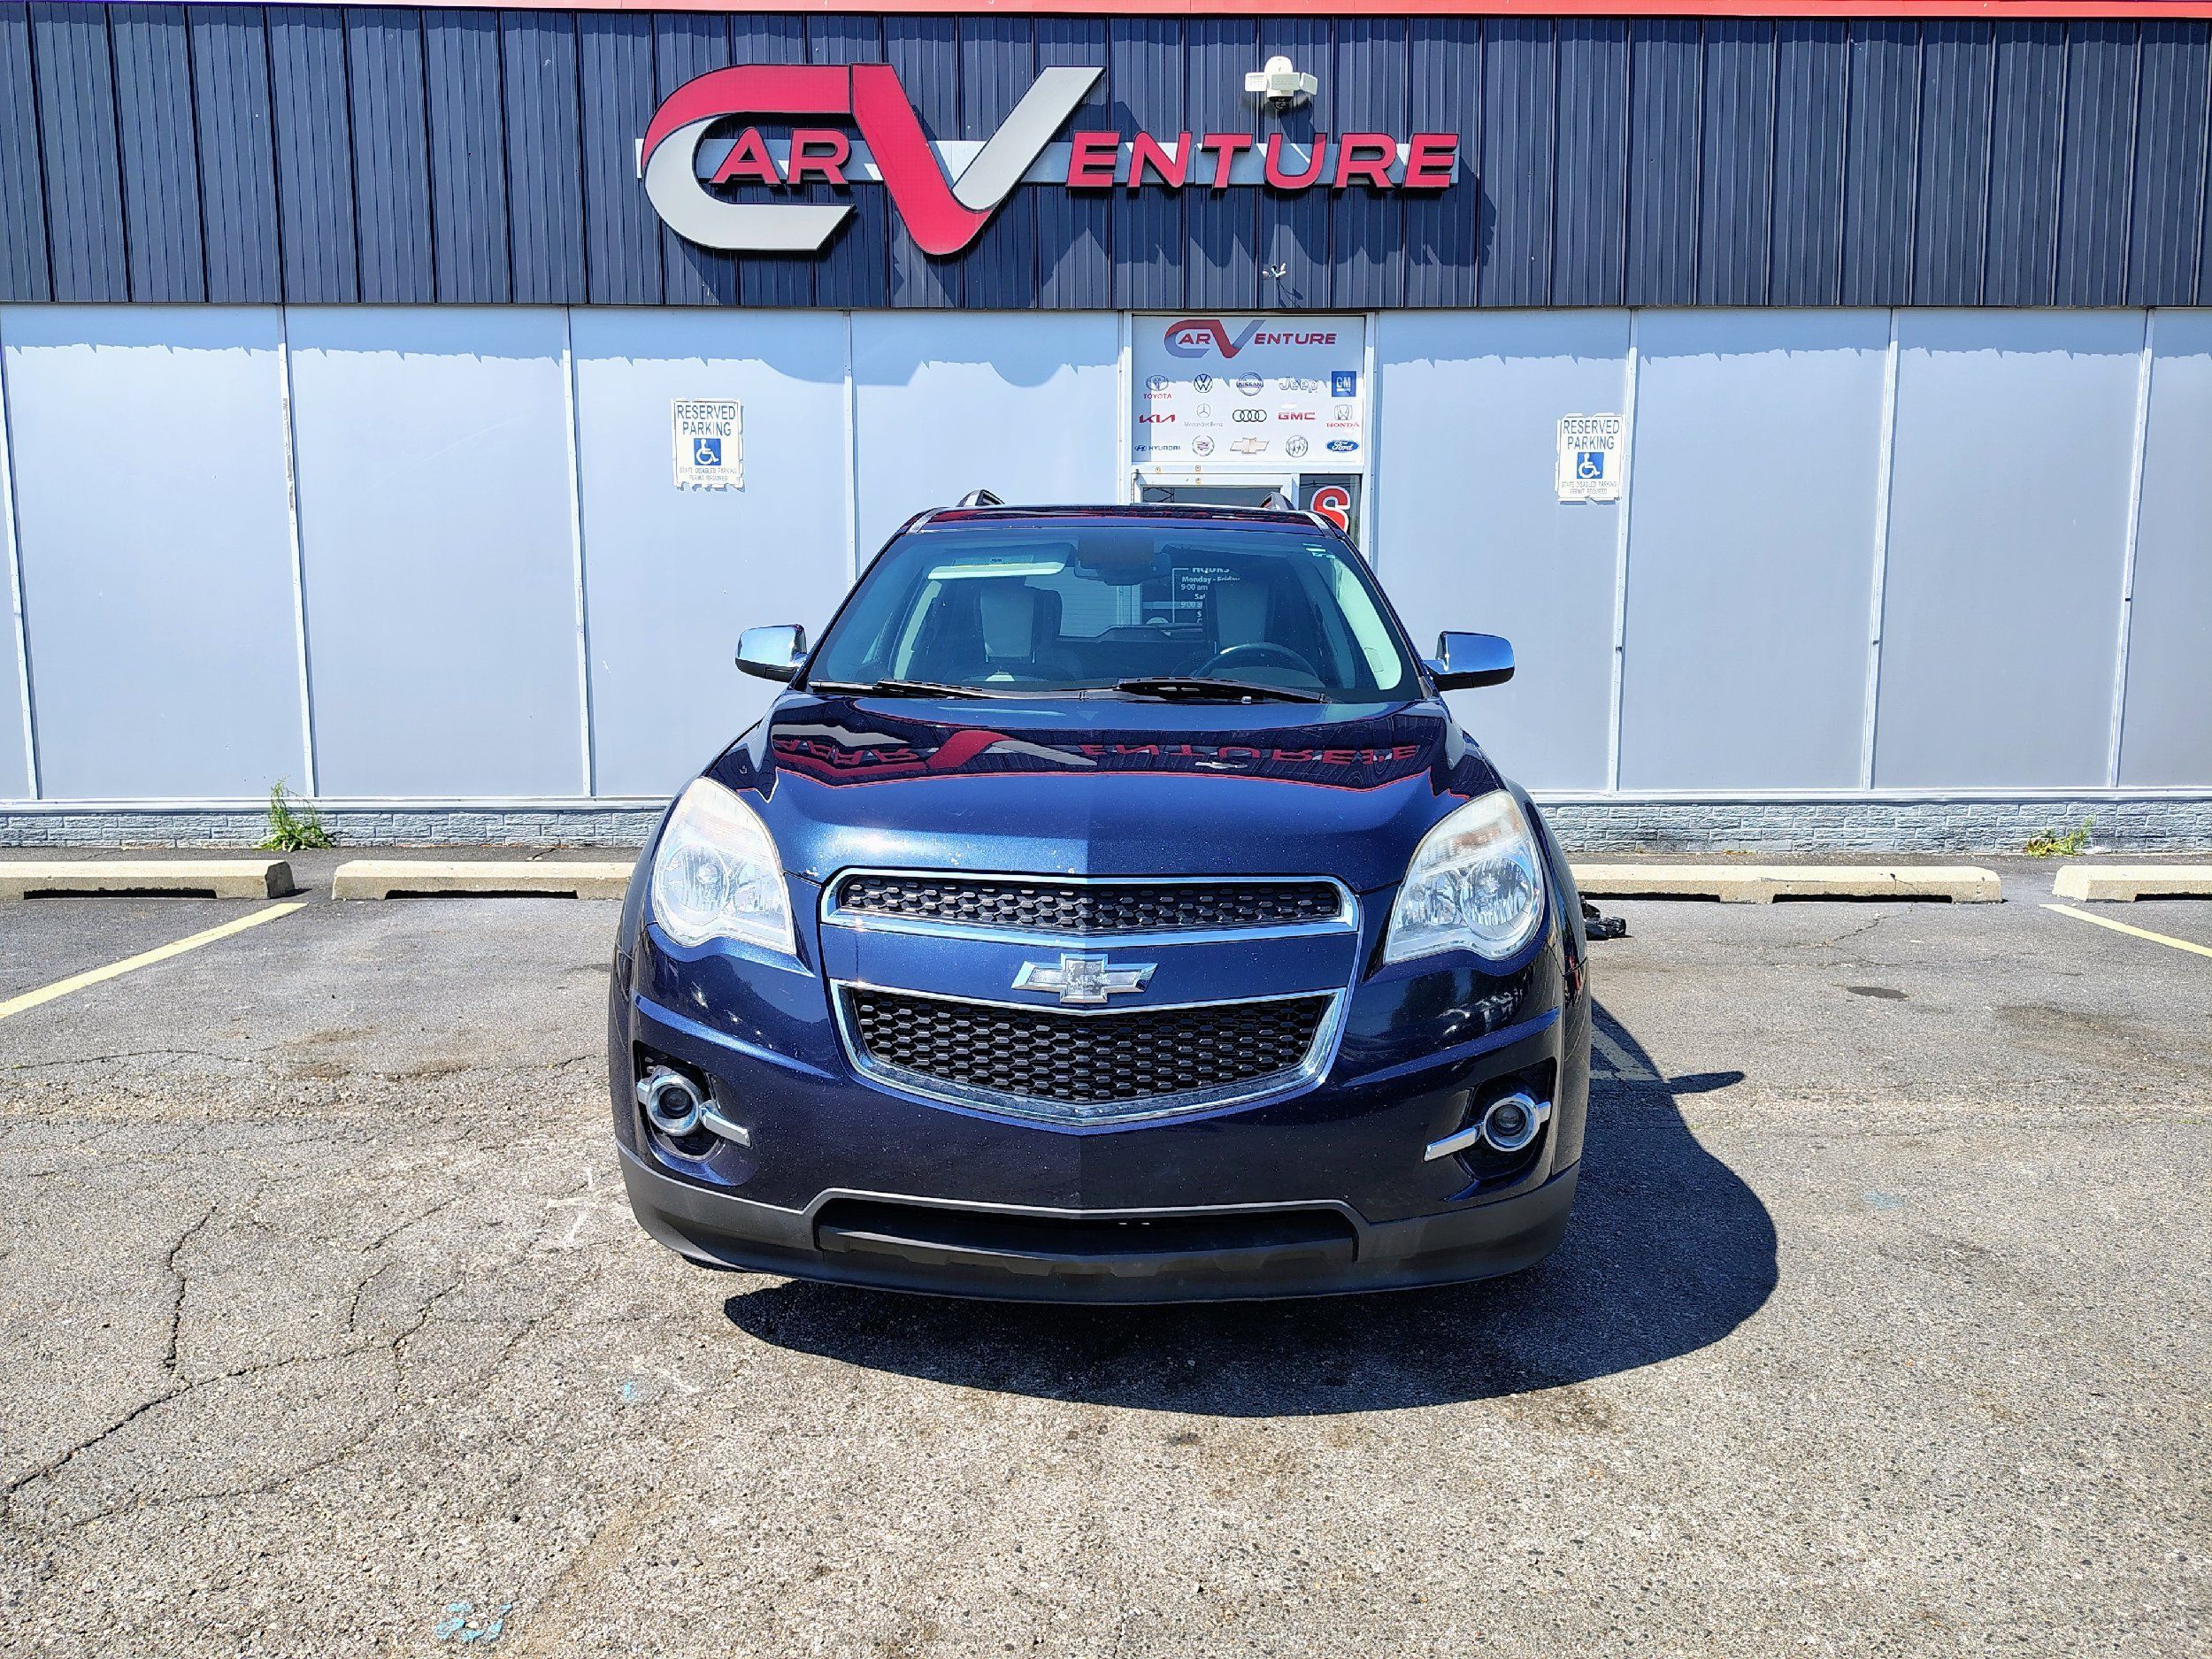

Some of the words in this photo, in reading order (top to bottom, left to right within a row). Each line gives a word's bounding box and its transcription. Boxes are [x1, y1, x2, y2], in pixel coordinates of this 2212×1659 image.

[1279, 376, 1319, 393] Jeep
[1336, 376, 1351, 388] GM
[677, 404, 735, 420] RESERVED
[1139, 414, 1176, 423] KIA
[1278, 411, 1317, 420] GMC
[682, 421, 732, 436] PARKING
[1563, 419, 1620, 434] RESERVED
[1331, 441, 1353, 450] Ford
[1567, 435, 1615, 449] PARKING
